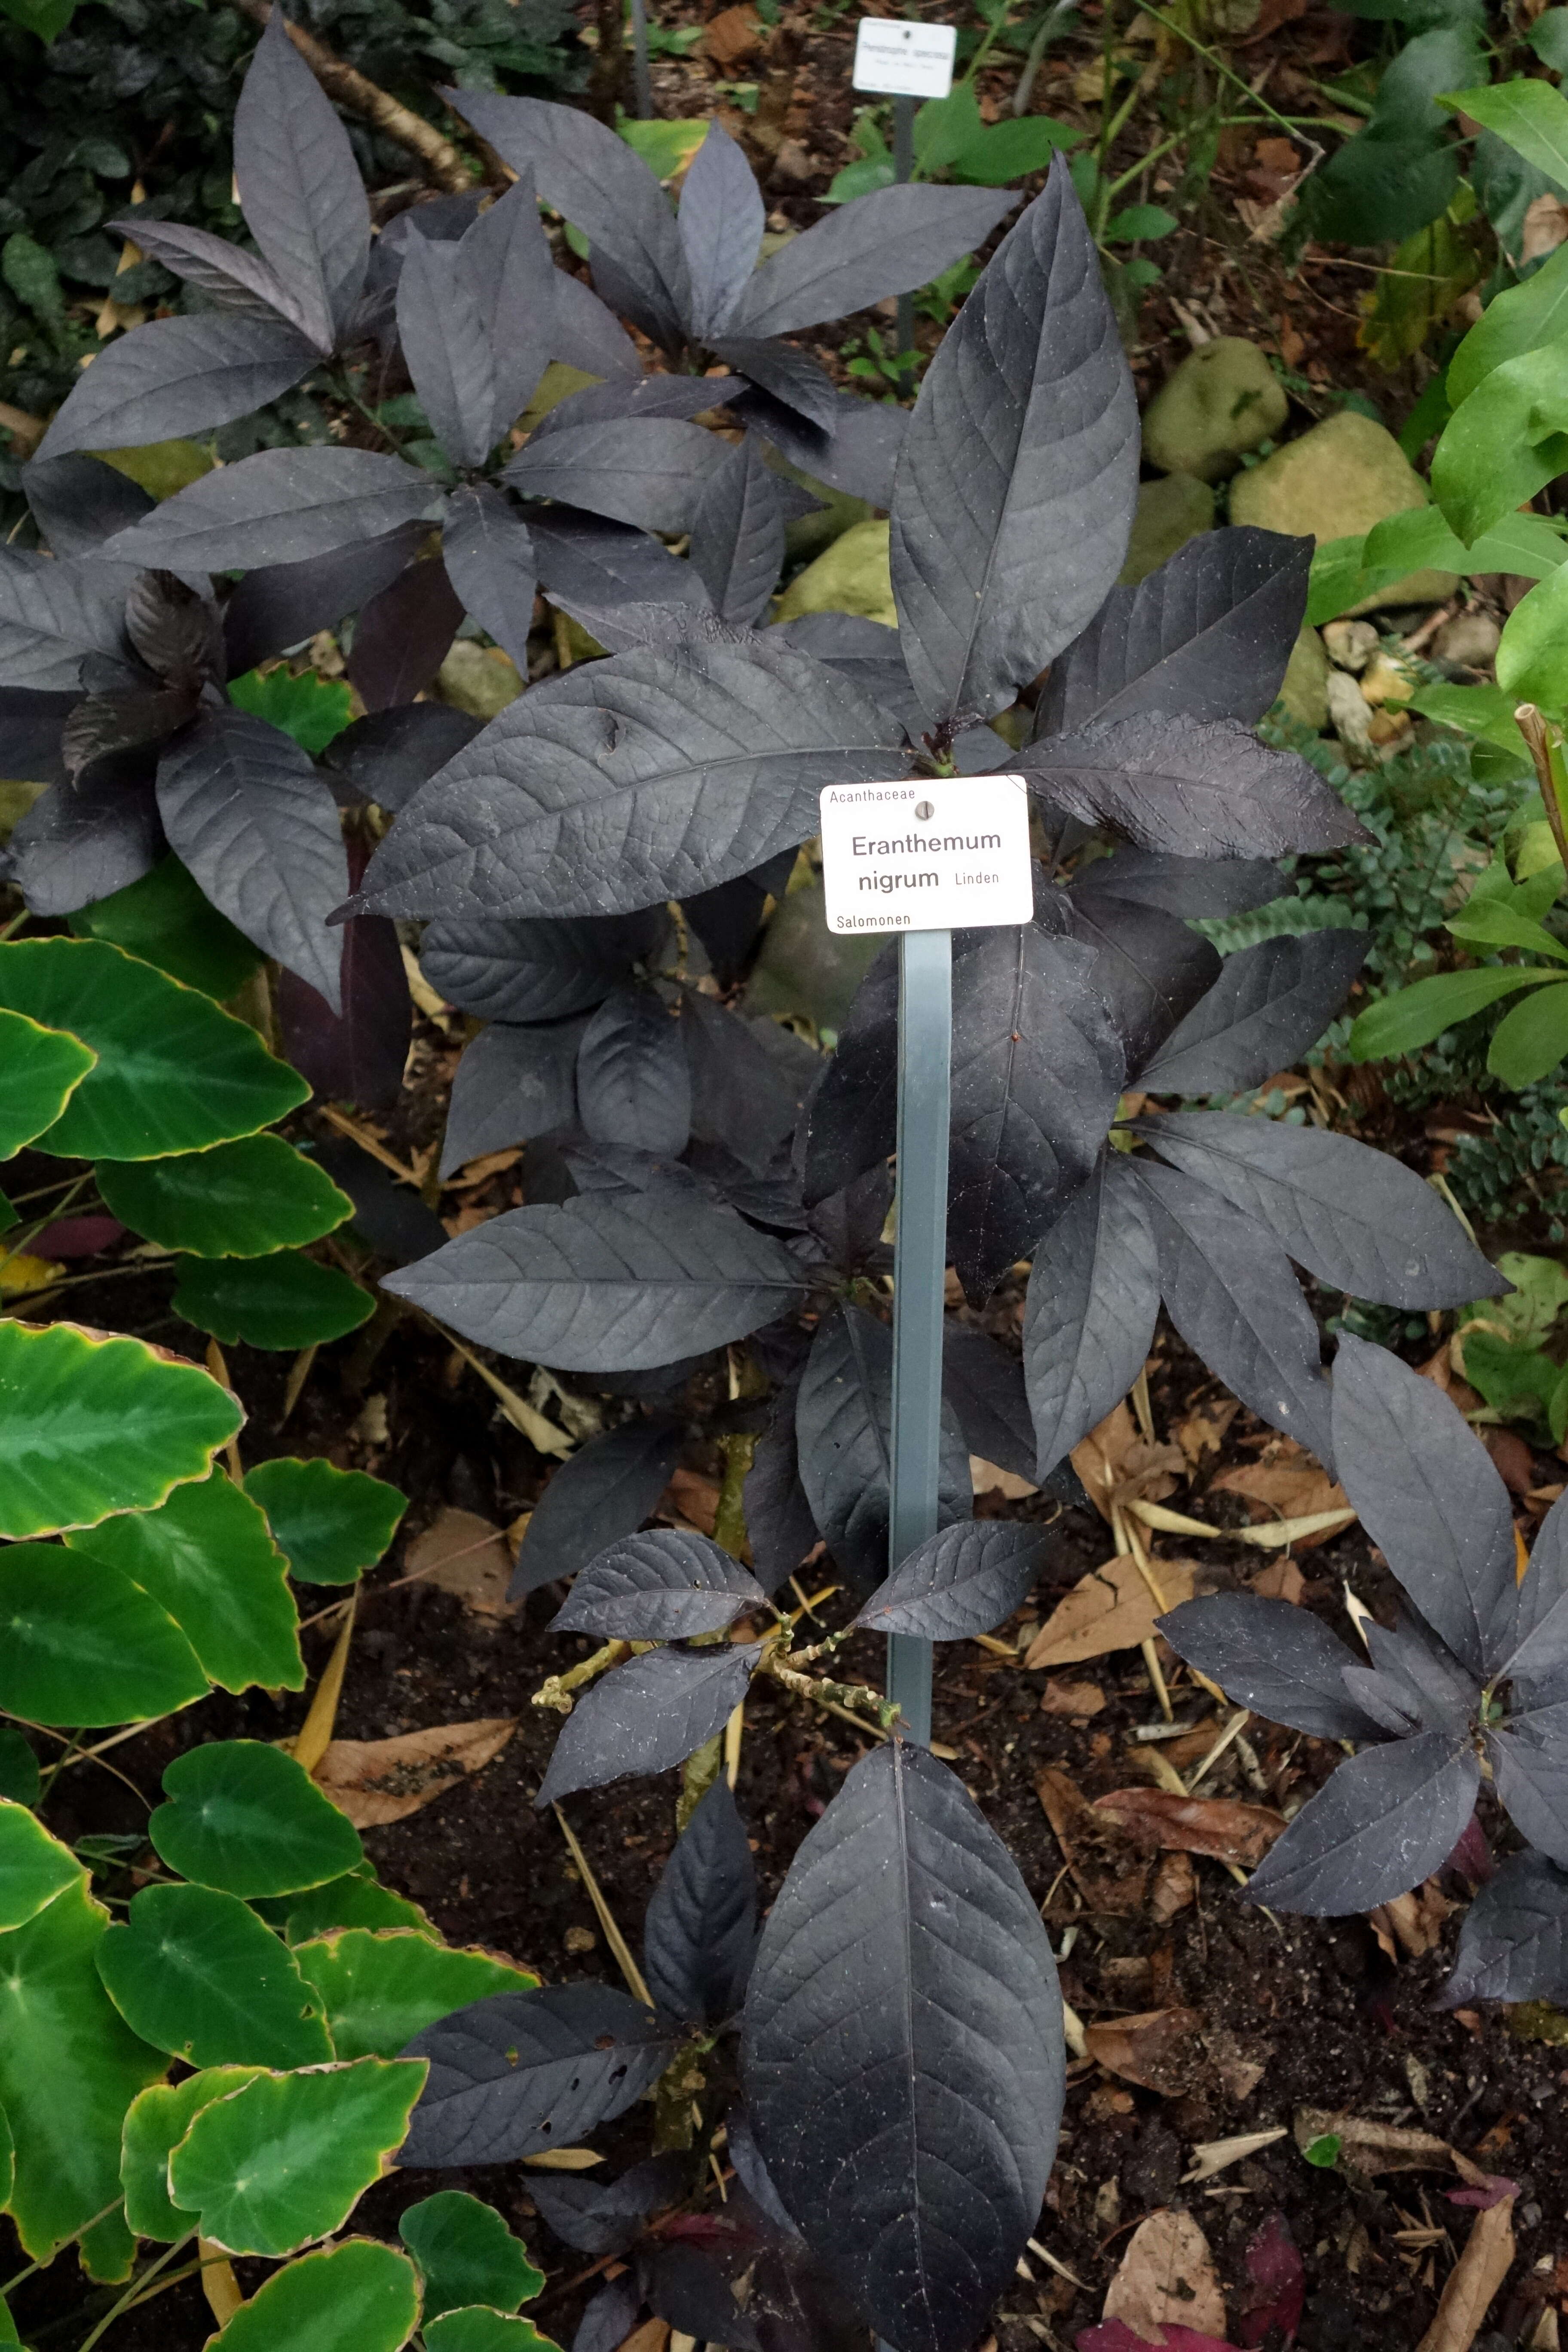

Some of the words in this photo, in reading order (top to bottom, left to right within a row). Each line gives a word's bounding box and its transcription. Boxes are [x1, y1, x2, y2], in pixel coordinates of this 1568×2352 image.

[830, 789, 915, 803] Acanthaceae
[852, 833, 1001, 856] Eranthemum
[859, 871, 939, 893] nigrum
[956, 872, 998, 885] Linden
[837, 915, 910, 928] Salomonen
